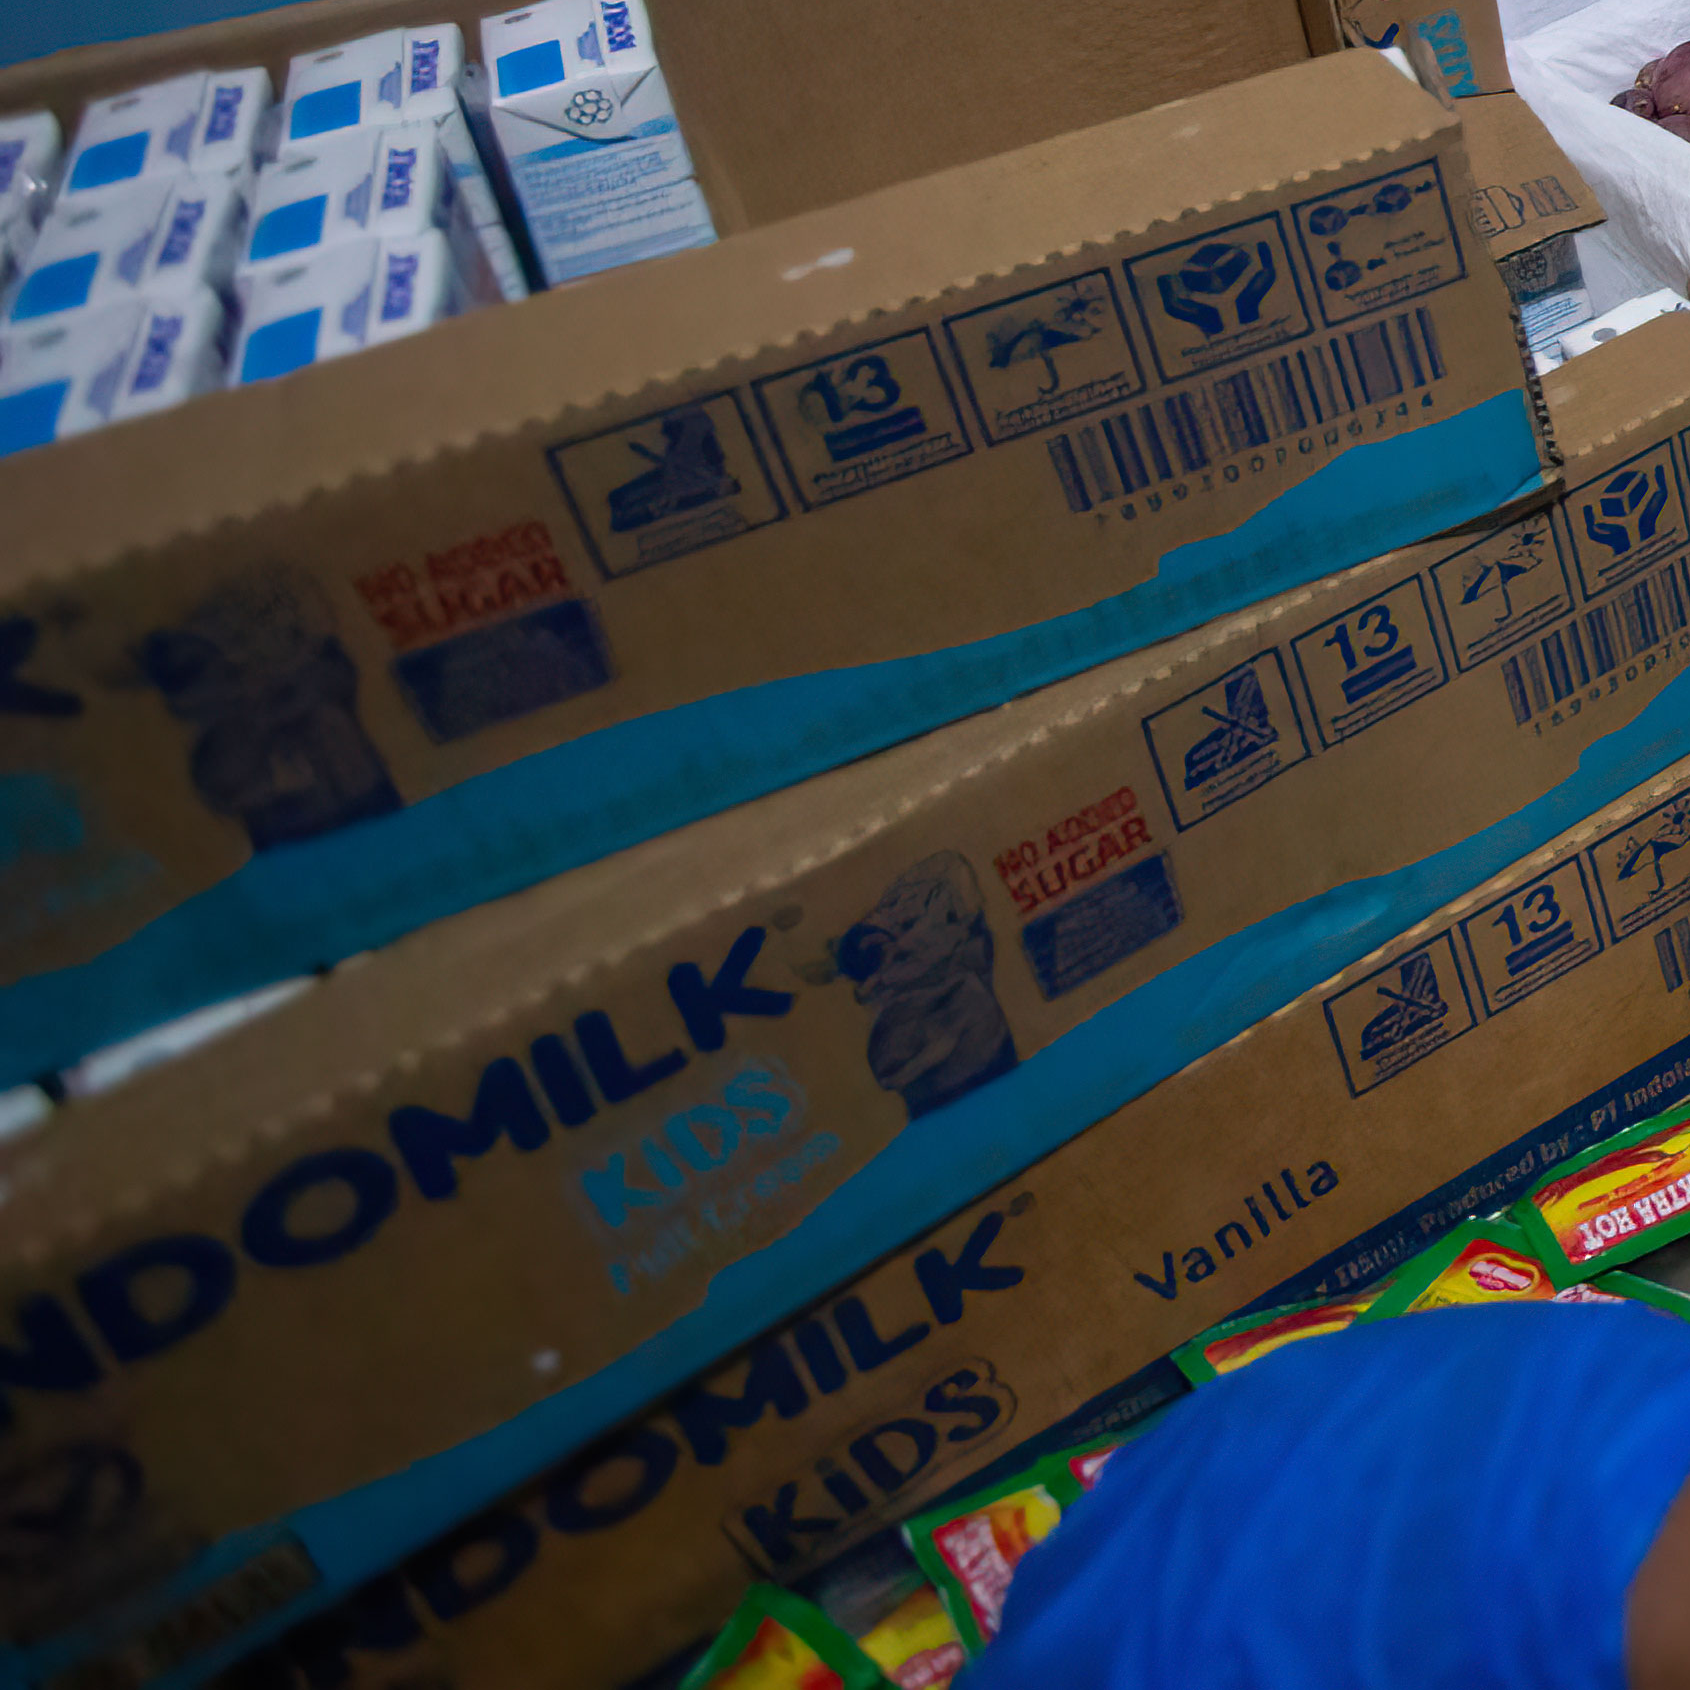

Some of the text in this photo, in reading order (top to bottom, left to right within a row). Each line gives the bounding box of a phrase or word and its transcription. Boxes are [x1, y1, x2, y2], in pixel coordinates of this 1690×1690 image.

[801, 354, 902, 422] 13
[1323, 604, 1399, 671] 13
[1010, 816, 1154, 914] SUGAR
[1492, 884, 1561, 946] 13
[0, 926, 794, 1435] NDOMILK
[583, 1070, 792, 1229] KIDS
[1133, 1152, 1341, 1303] Vanilla
[1577, 1199, 1643, 1252] HOT
[742, 1367, 1003, 1564] KIDS
